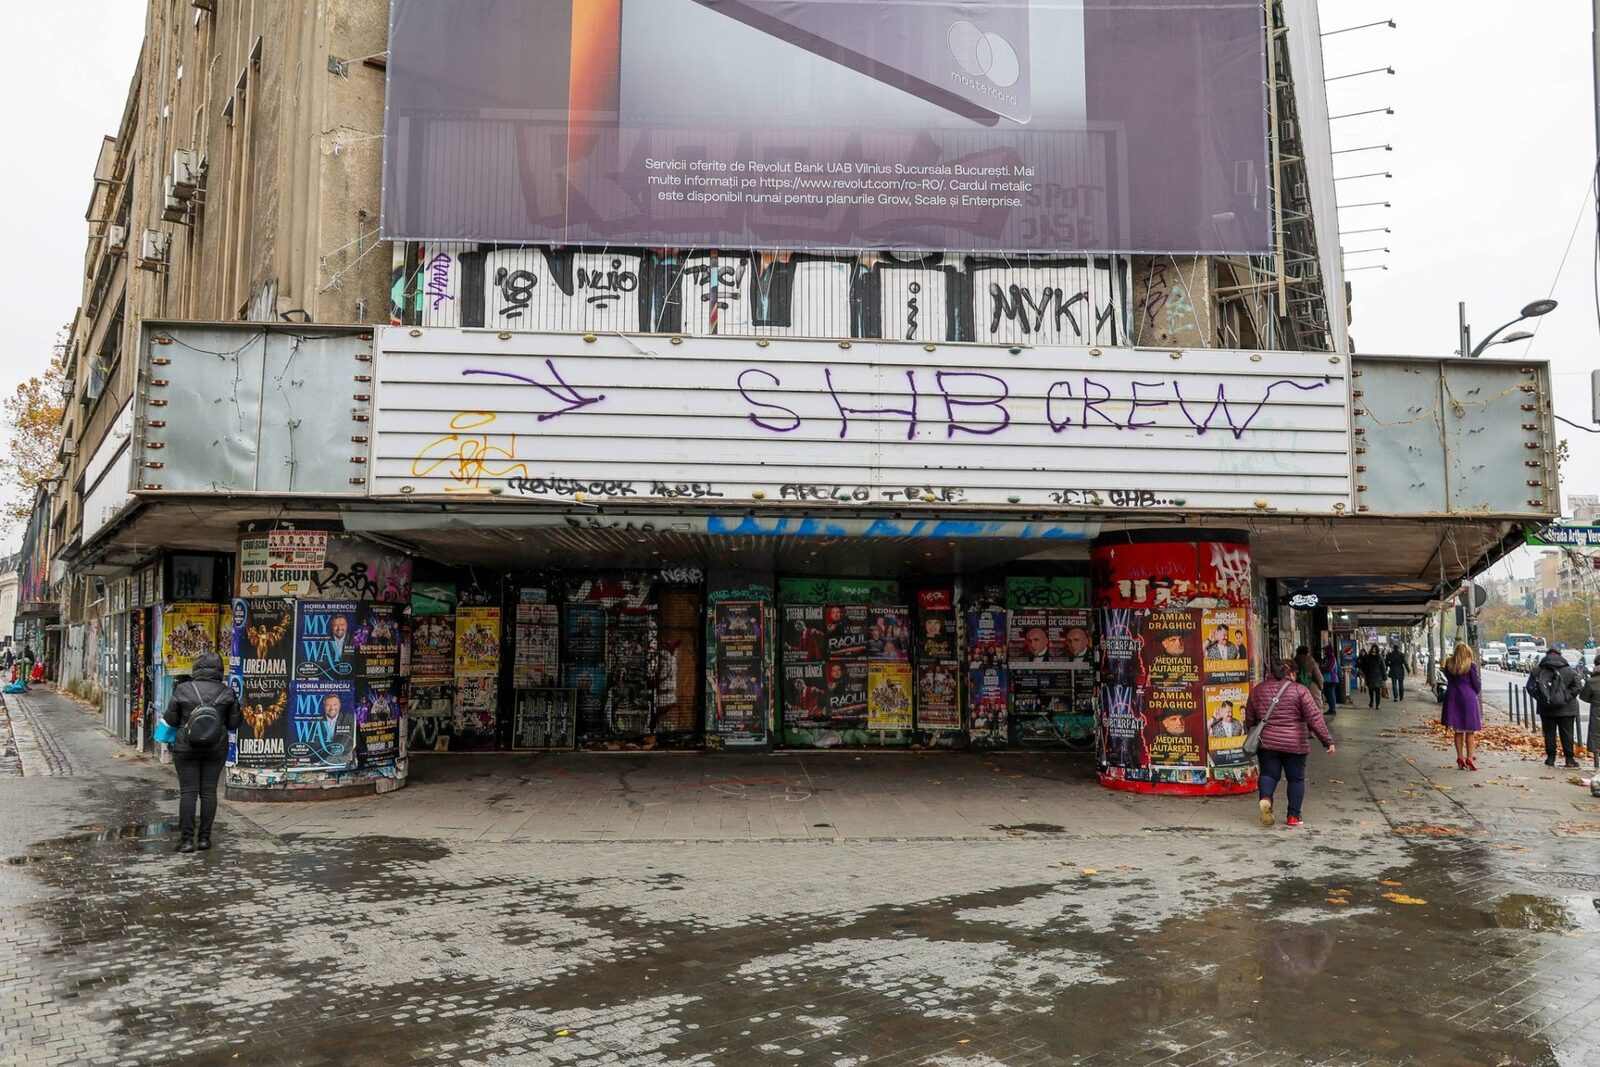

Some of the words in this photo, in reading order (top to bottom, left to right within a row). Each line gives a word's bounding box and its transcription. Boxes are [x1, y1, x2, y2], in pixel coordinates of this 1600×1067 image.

[950, 71, 1018, 106] mastercard
[645, 158, 687, 170] Servicii
[689, 159, 727, 171] oferite
[730, 160, 746, 172] de
[749, 161, 792, 173] Revolut
[795, 162, 824, 173] Bank
[827, 163, 852, 174] UAB
[855, 163, 892, 174] Vilnius
[895, 163, 951, 175] Sucursala
[954, 164, 1011, 178] București.
[1014, 165, 1035, 177] Mai
[648, 174, 681, 186] multe
[684, 175, 738, 188] informații
[741, 178, 757, 189] pe
[949, 179, 987, 191] Cardul
[990, 180, 1032, 192] metalic
[658, 191, 684, 201] este
[687, 190, 742, 204] disponibil
[746, 192, 782, 203] numai
[784, 193, 823, 205] pentru
[826, 193, 874, 206] planurile
[878, 194, 912, 206] Grow,
[915, 194, 947, 206] Scale
[949, 195, 959, 208] și
[962, 195, 1023, 209] Enterprise.
[737, 368, 1010, 440] SHB
[1047, 375, 1330, 440] CREW
[1547, 529, 1568, 542] Strada
[303, 614, 332, 636] MY
[828, 634, 868, 649] RAOUL
[303, 639, 345, 665] WAY
[243, 658, 287, 675] LOREDANA
[1193, 665, 1199, 673] 2
[1153, 692, 1192, 700] DAMIAN
[1219, 687, 1242, 696] MIHAI
[294, 694, 325, 715] MY
[294, 720, 333, 746] WAY
[239, 738, 285, 754] LOREDANA
[1194, 745, 1200, 753] 2
